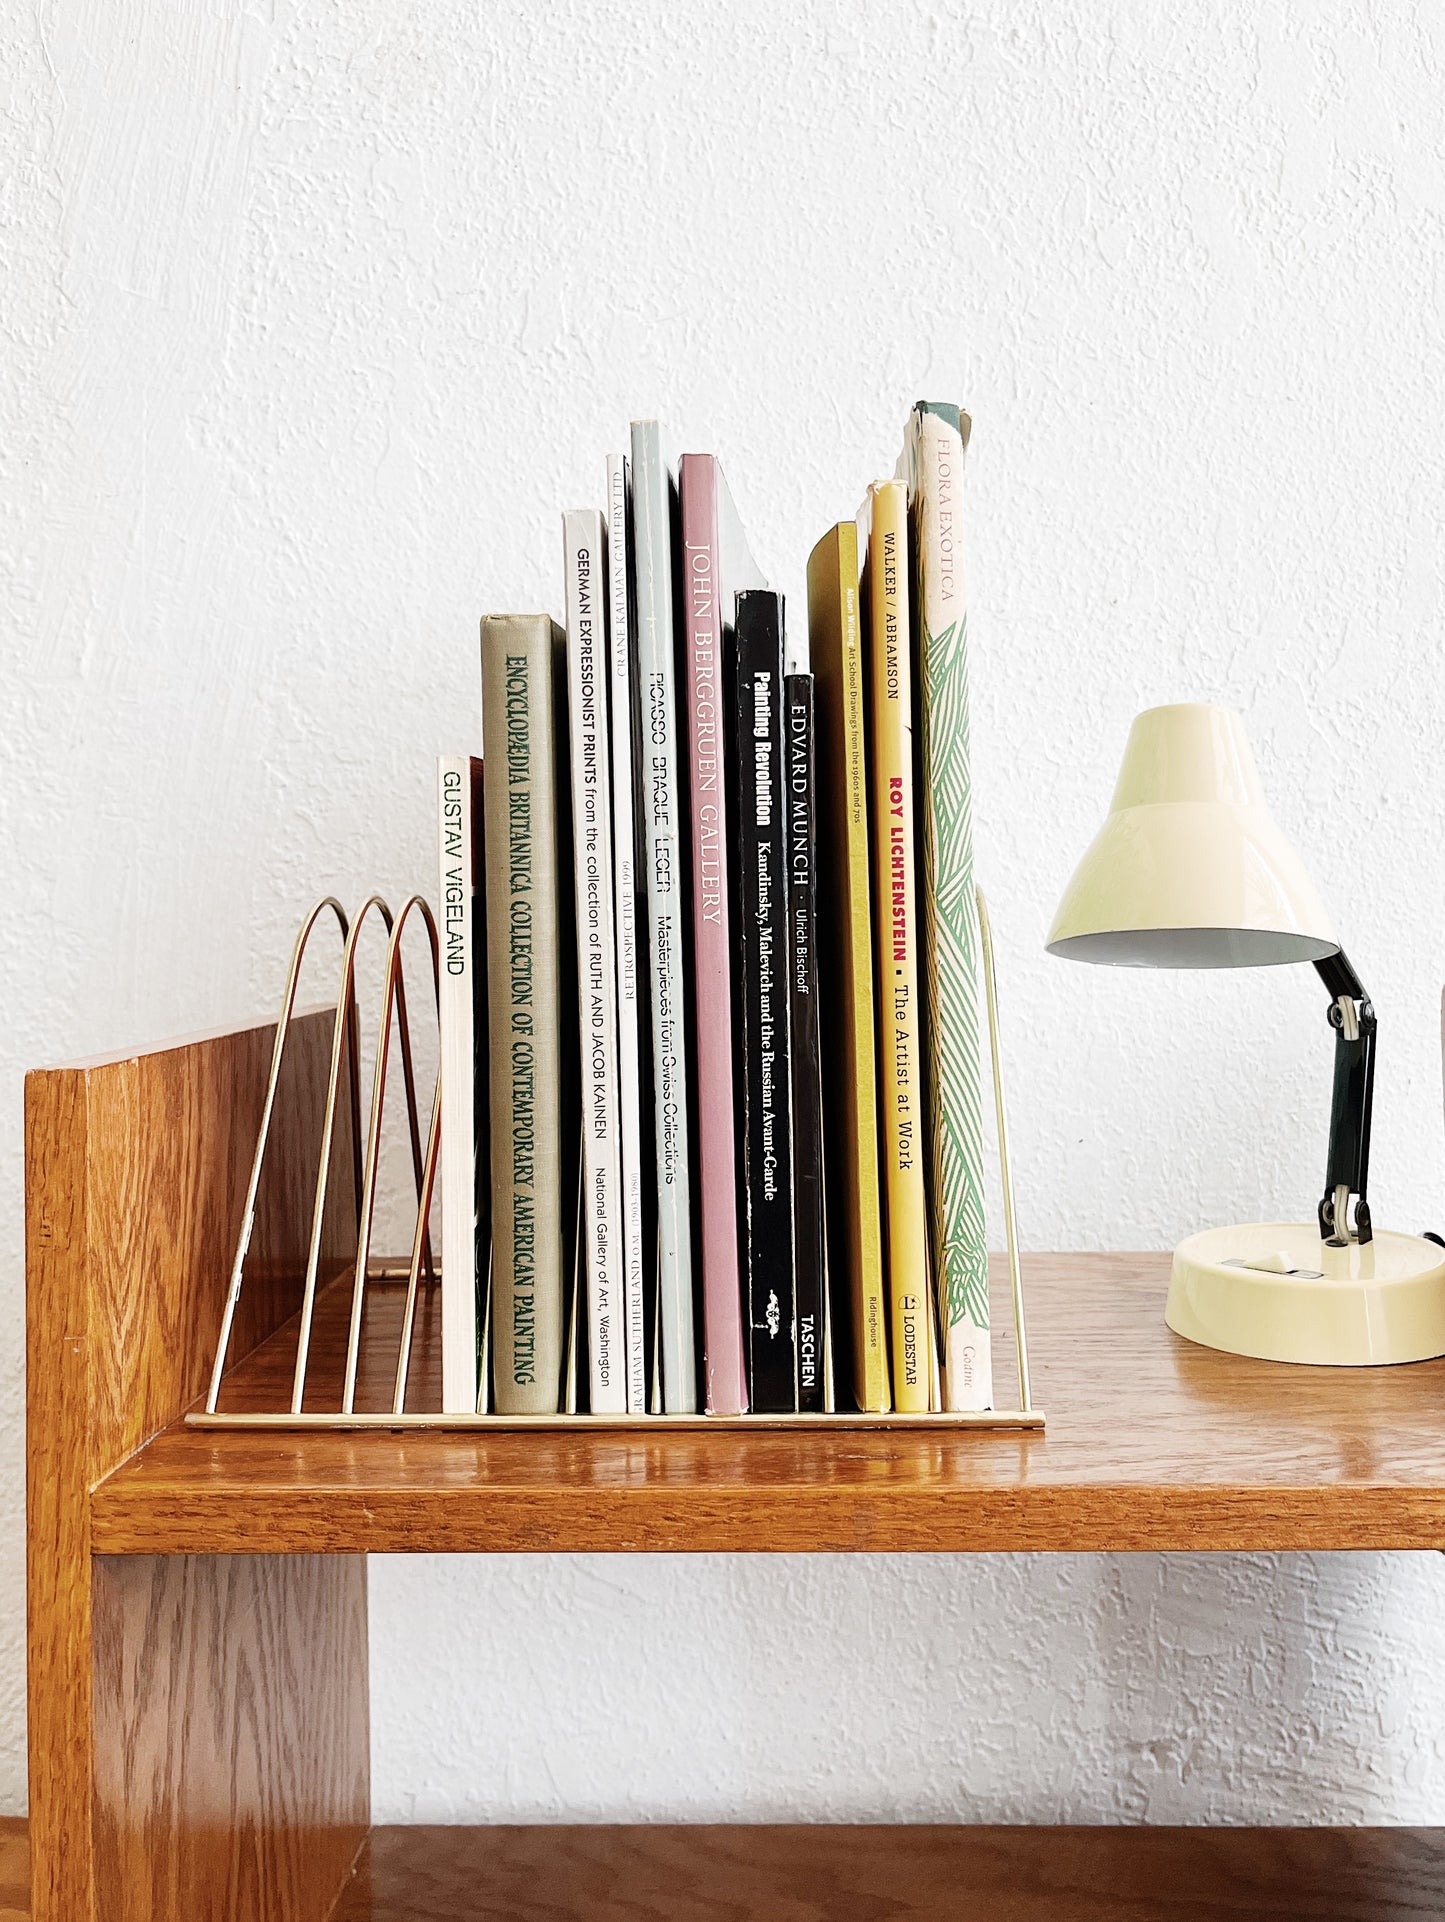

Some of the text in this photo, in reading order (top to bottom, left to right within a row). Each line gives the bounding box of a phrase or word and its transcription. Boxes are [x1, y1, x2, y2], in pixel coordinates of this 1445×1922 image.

[884, 532, 896, 596] WALKER
[938, 438, 954, 601] FLORA EXOTICA
[613, 472, 626, 677] CRANE KALMAN GALLERY LTD
[846, 588, 854, 614] Alison
[847, 614, 856, 647] Wilding
[848, 662, 857, 690] School
[886, 613, 898, 700] ABRAMSON
[685, 540, 721, 926] JOHN BERGGRUEN GALLERY
[850, 691, 858, 729] Drawings
[443, 771, 465, 976] GUSTAV VIGELAND
[508, 790, 533, 896] BRITANNICA
[577, 548, 607, 1140] GERMAN EXPRESSIONIST PRINTS from the collection of RUTH AND JACOB KAINEN
[790, 704, 808, 994] EDVARD MUNCH Ulrich Bischoff
[509, 900, 533, 1007] COLLECTION
[622, 860, 634, 1000] RETROSPECTIVE 1999
[650, 673, 679, 1185] PICASSO BRAQUE LEGER Masterpieces from Swiss Collections
[753, 672, 778, 1201] Painting Revolution Kandinsky, Malevich and the Russian Avant-Garde
[889, 777, 914, 1170] ROY LICHTENSTEIN The Artist at Work
[511, 1012, 534, 1036] OF
[510, 1041, 536, 1189] CONTEMPORARY
[512, 1192, 536, 1288] AMERICAN
[596, 1168, 610, 1387] National Gallery of Art, Washington
[513, 1294, 536, 1386] PAINTING
[630, 1259, 641, 1352] SUTHERLAND
[800, 1314, 814, 1387] TASCHEN
[868, 1296, 877, 1348] Ridinghouse
[904, 1316, 917, 1386] LODESTAR
[632, 1356, 643, 1412] RAHAM
